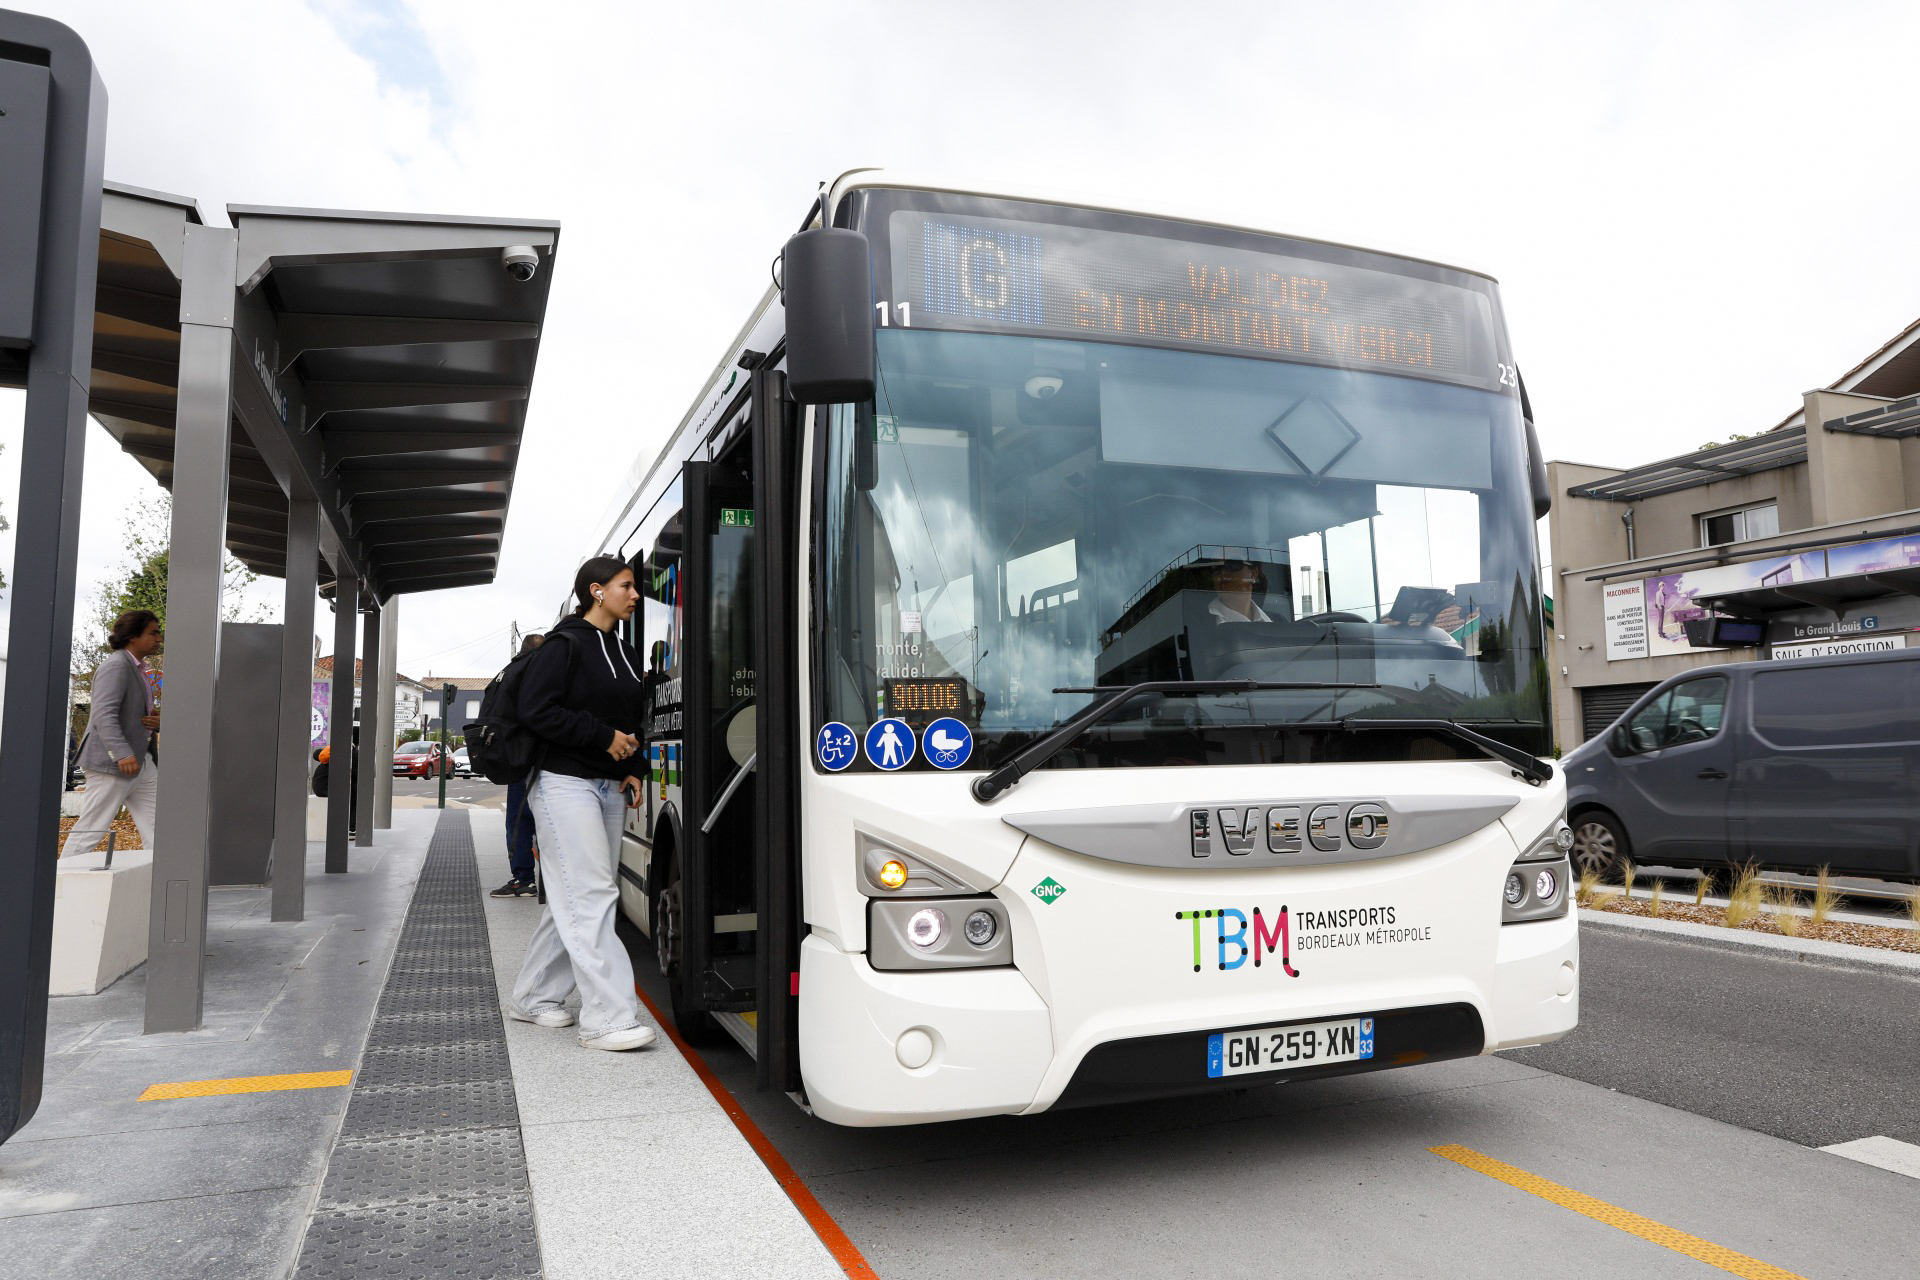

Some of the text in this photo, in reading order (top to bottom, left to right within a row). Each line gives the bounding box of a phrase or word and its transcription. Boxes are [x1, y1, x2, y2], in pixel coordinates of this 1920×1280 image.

[961, 238, 1007, 308] G
[1187, 262, 1329, 315] VALIDEZ
[876, 301, 911, 327] 11
[1074, 288, 1432, 369] EN MONTANT MERCI
[1497, 363, 1515, 388] 23
[1607, 587, 1640, 597] MACONNERIE
[1617, 618, 1643, 627] CONSTRUCTION
[1794, 617, 1874, 637] Le Grand Louis G
[893, 684, 958, 711] 90106
[1190, 802, 1390, 859] IVECO
[1035, 885, 1062, 897] GNC
[1296, 906, 1396, 931] TRANSPORTS
[1175, 904, 1300, 979] TBM
[1297, 926, 1432, 951] BORDEAUX MÉTROPOLE
[1360, 1039, 1373, 1055] 33
[1212, 1059, 1219, 1070] F
